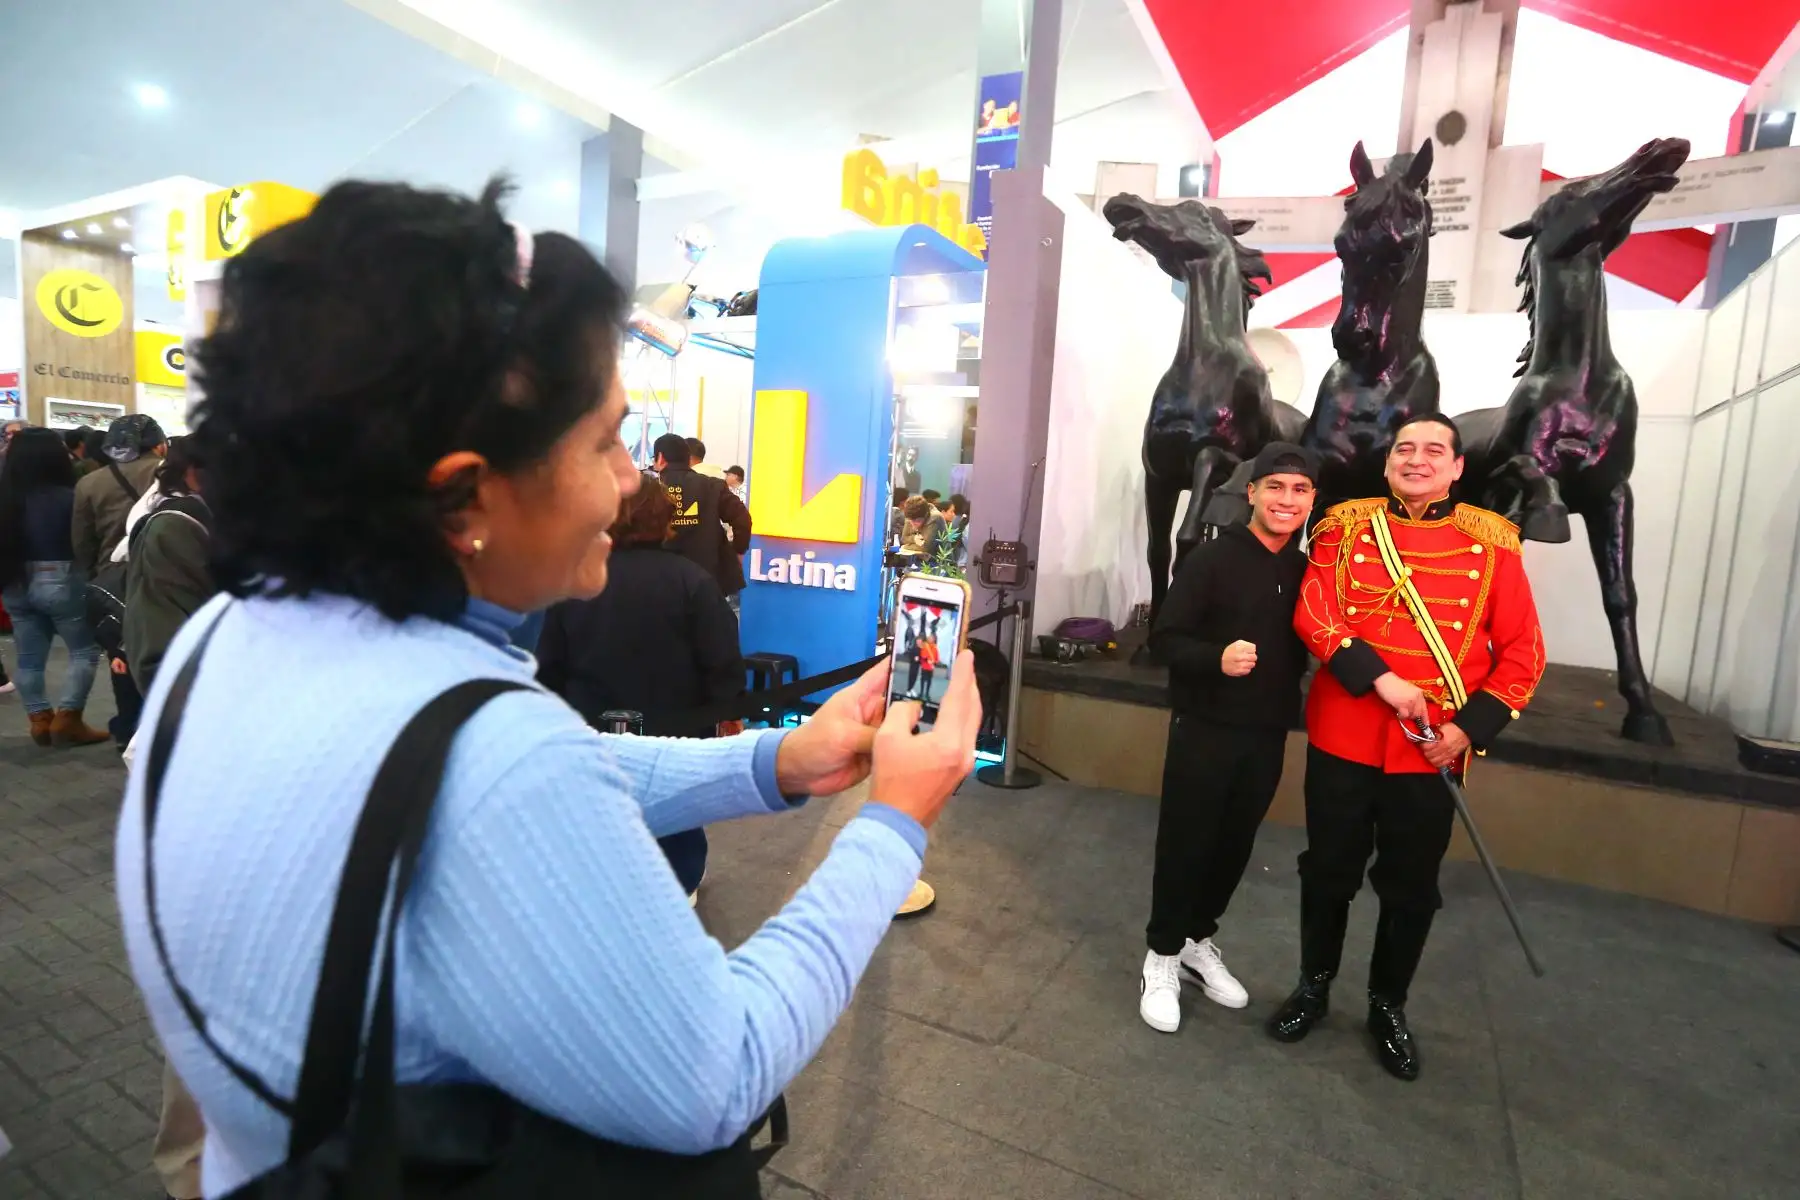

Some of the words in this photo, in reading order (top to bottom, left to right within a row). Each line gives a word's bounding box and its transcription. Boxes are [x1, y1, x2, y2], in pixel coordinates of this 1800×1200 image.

[54, 282, 107, 327] C
[34, 362, 54, 376] El
[58, 366, 130, 386] Comercio
[750, 548, 856, 592] Latina
